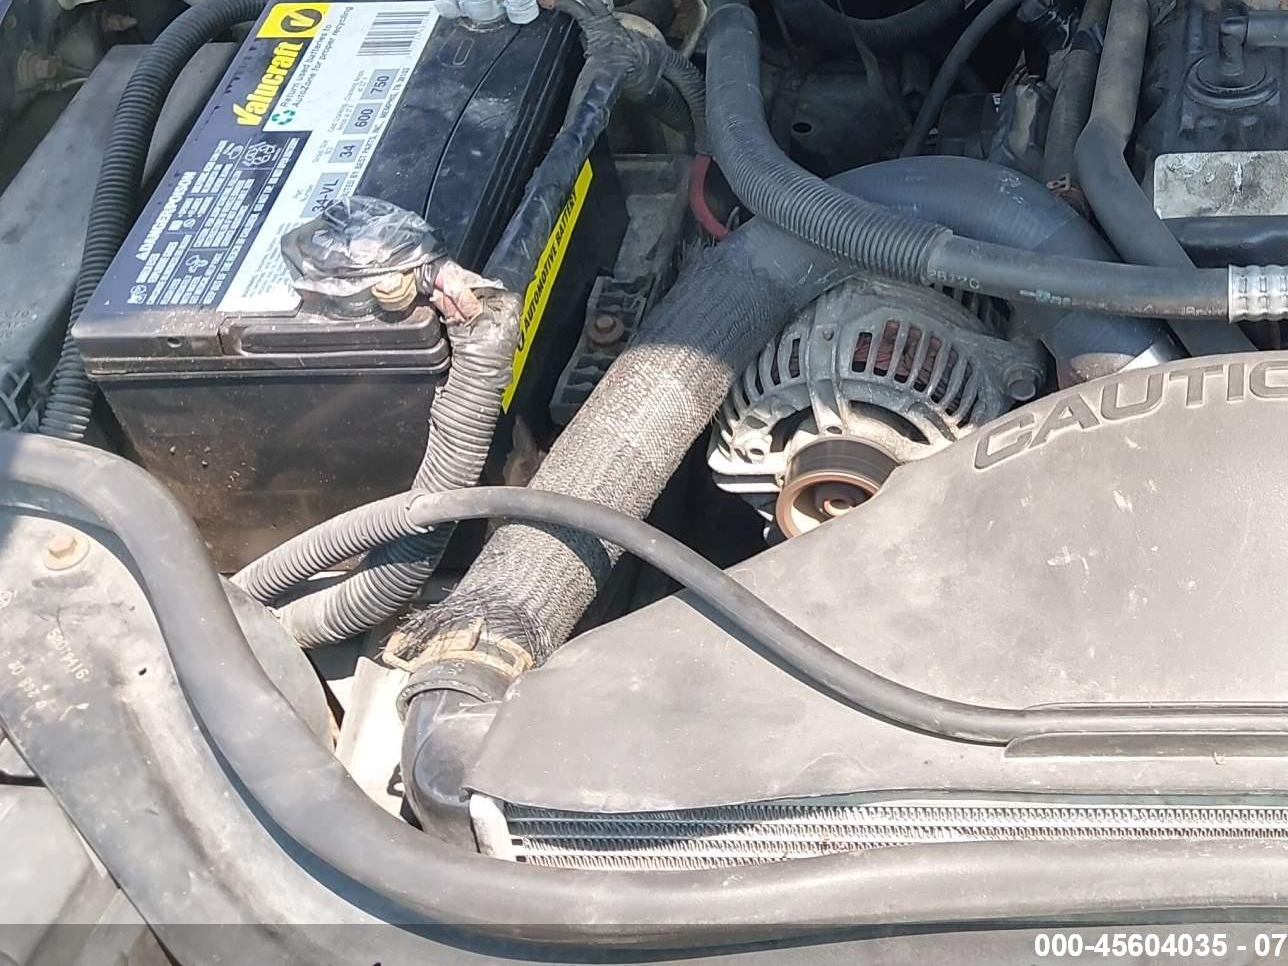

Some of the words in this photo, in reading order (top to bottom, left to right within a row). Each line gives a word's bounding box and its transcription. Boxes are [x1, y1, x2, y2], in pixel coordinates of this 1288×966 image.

[279, 83, 300, 107] Return
[293, 64, 310, 80] used
[304, 33, 327, 62] batteries
[290, 73, 316, 107] AutoZone
[310, 62, 322, 70] for
[317, 38, 337, 59] proper
[330, 6, 354, 35] recycling
[369, 75, 390, 93] 750
[353, 109, 374, 126] 600
[337, 145, 356, 157] 34
[309, 179, 340, 211] 34-VL
[523, 245, 557, 329] AUTOMOTIVE
[554, 191, 577, 245] BATTERY
